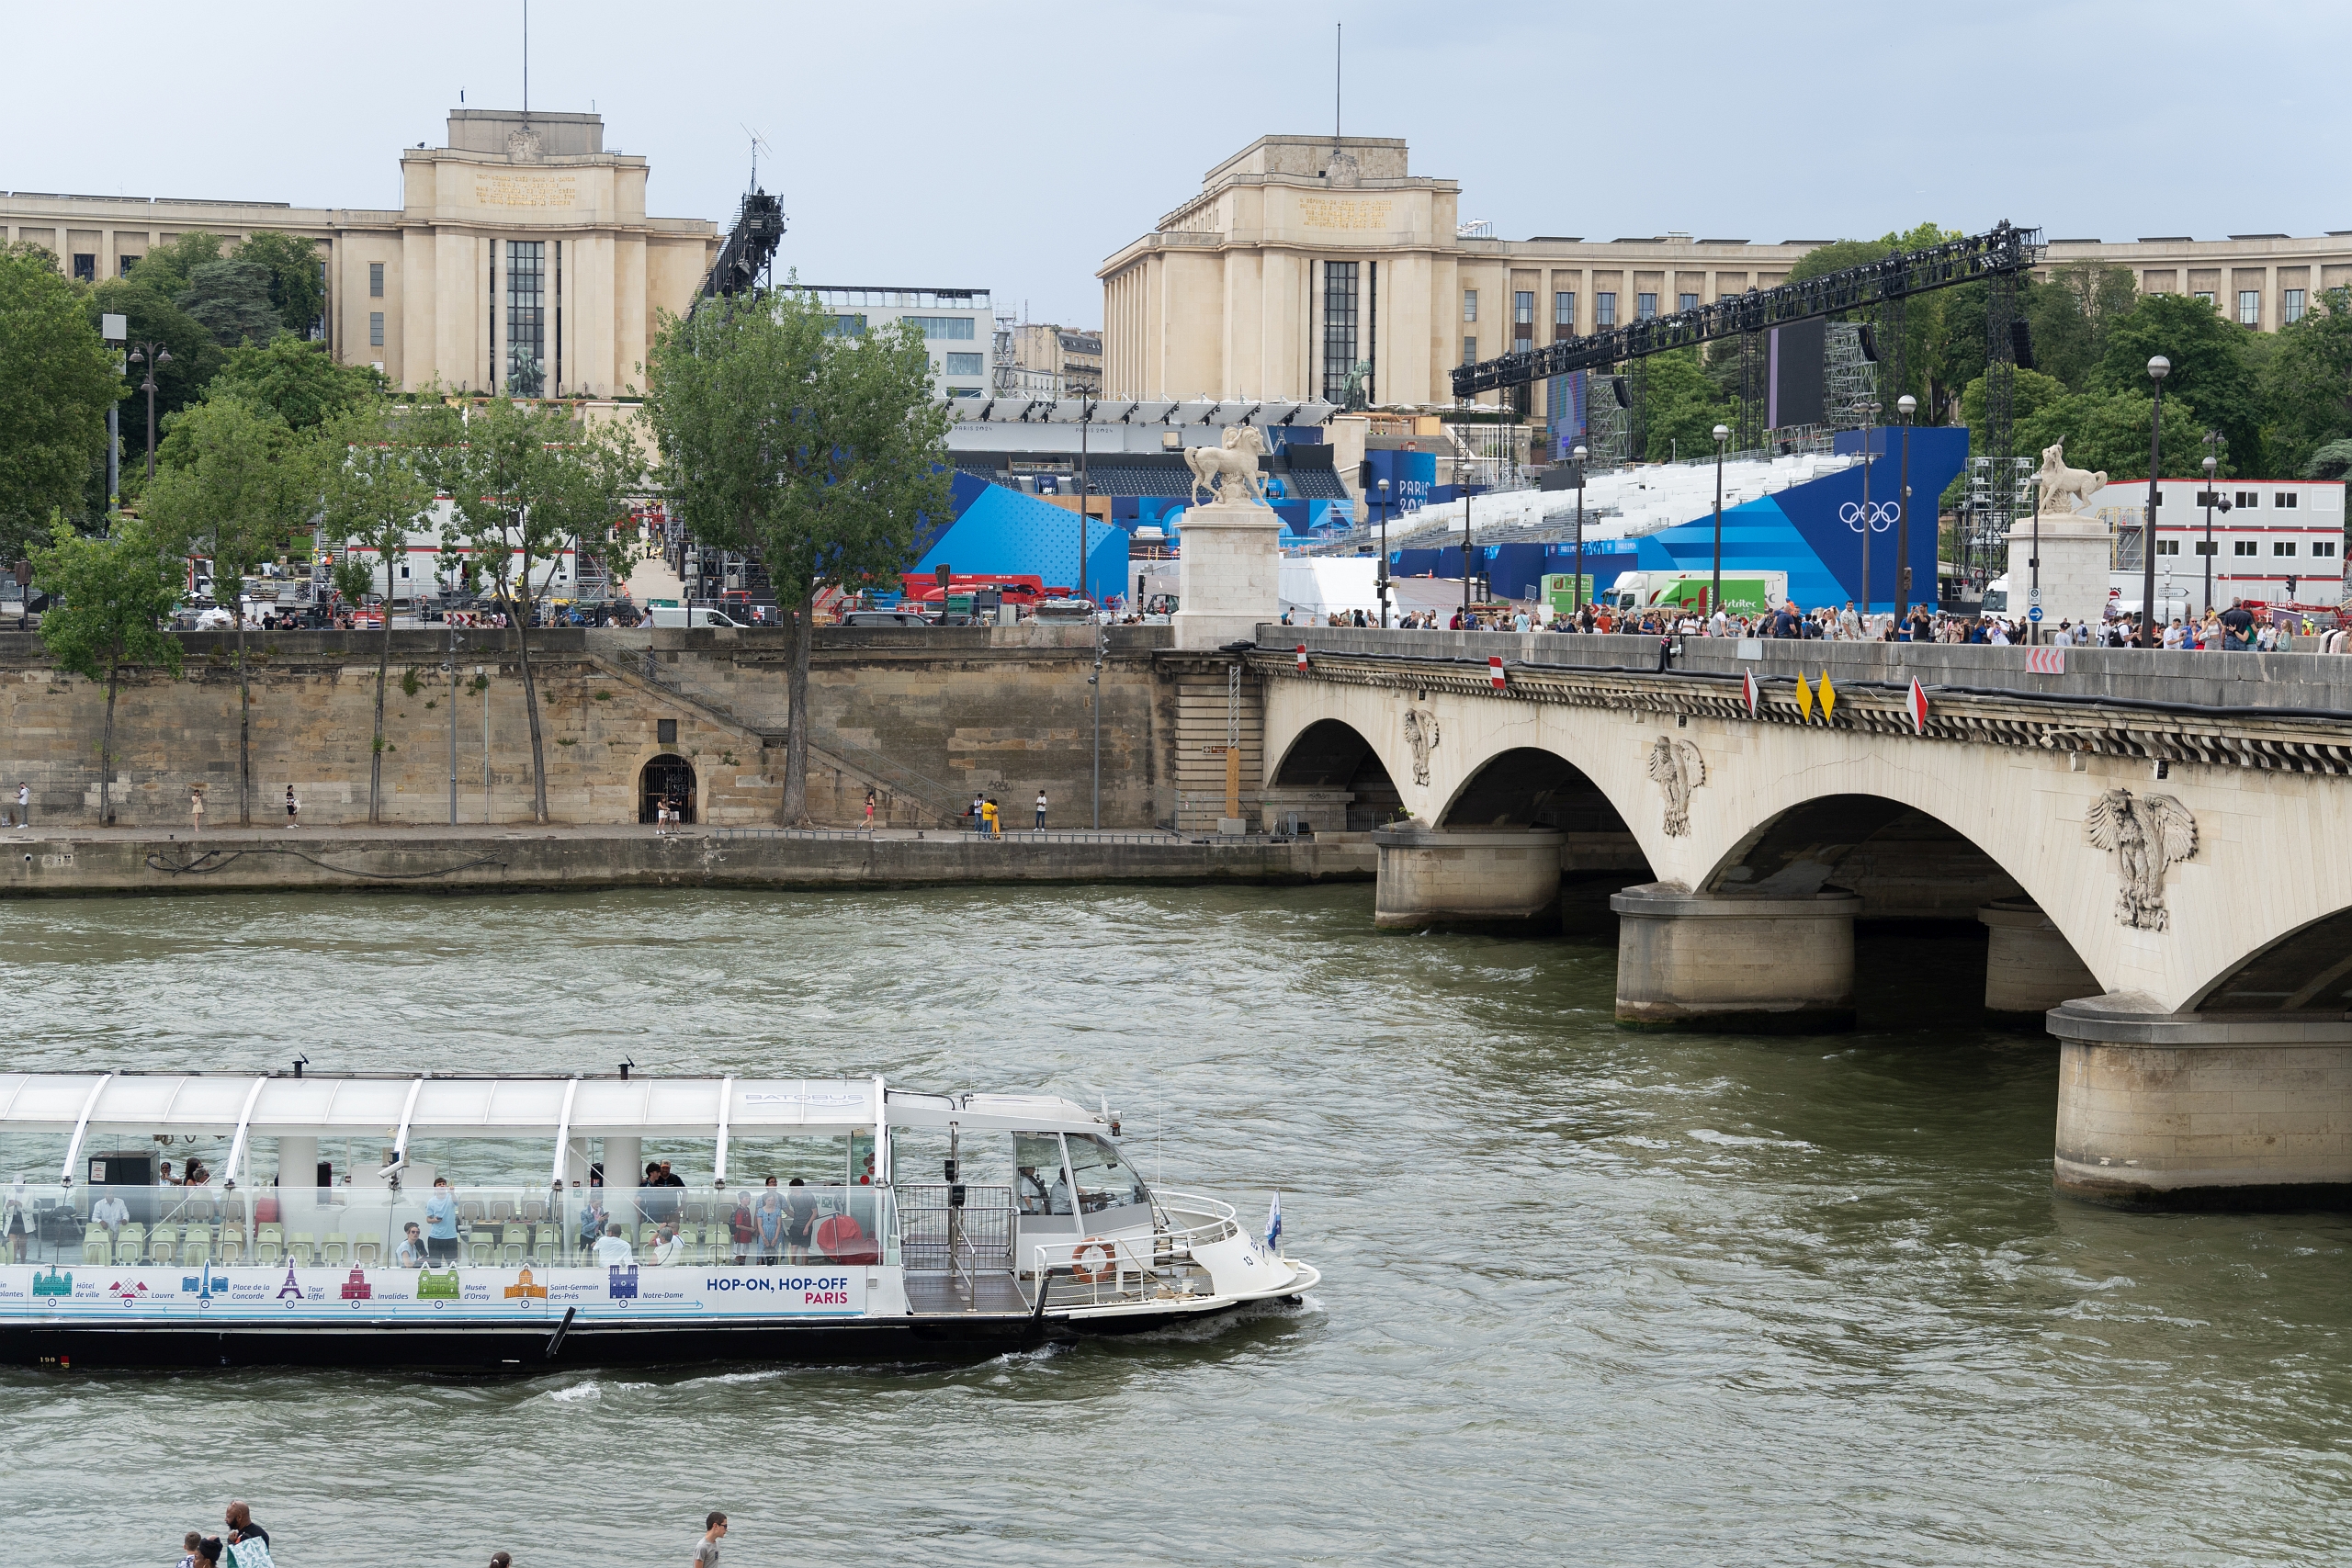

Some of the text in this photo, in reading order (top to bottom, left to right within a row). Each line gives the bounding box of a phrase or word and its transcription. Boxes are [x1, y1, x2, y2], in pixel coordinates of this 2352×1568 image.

[1722, 599, 1757, 608] istritec
[1243, 1256, 1254, 1266] 13
[707, 1278, 848, 1293] HOP-ON, HOP-OFF
[307, 1292, 325, 1301] Eiffel
[464, 1292, 491, 1301] d'Orsay
[805, 1292, 848, 1304] PARIS
